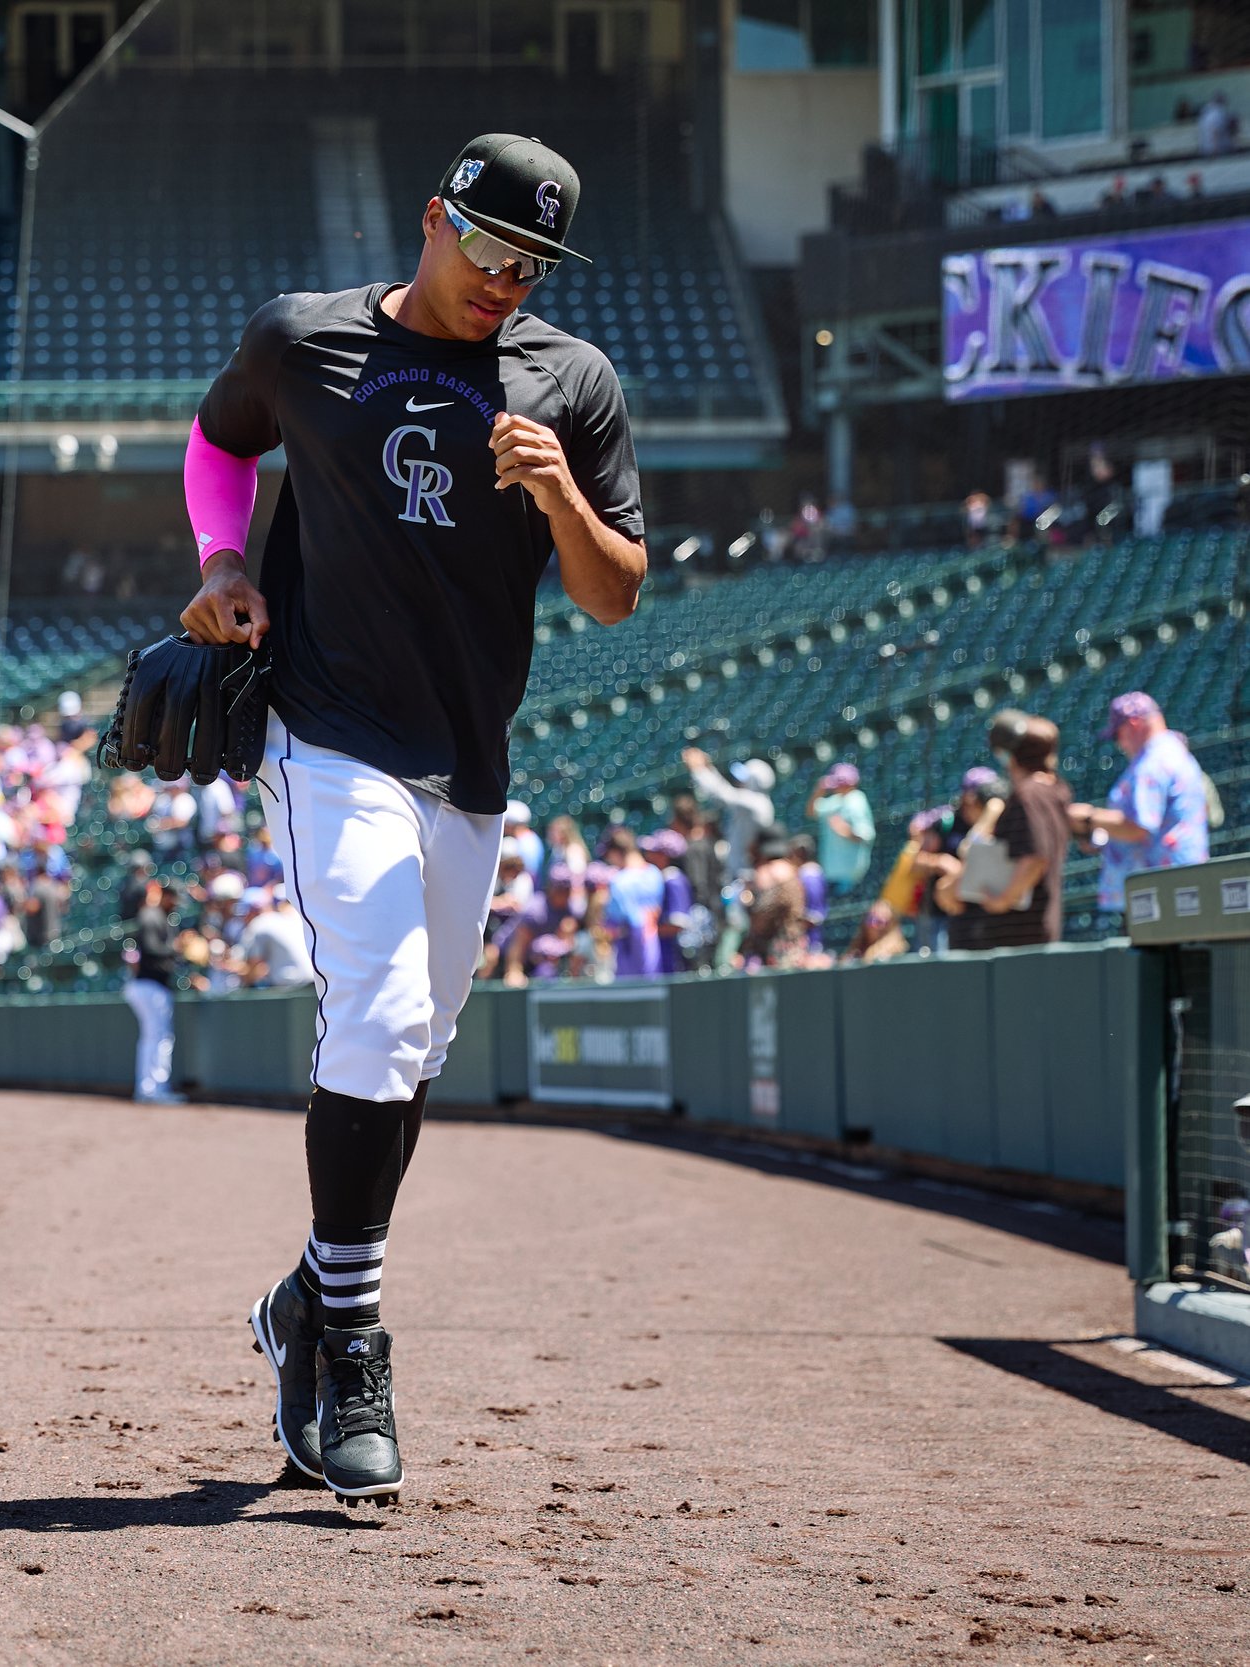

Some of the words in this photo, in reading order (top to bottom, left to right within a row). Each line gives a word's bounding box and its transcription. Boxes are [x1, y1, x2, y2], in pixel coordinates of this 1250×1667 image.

[353, 368, 430, 403] COLORADO
[435, 372, 496, 425] BASEBALL
[382, 424, 456, 527] CR
